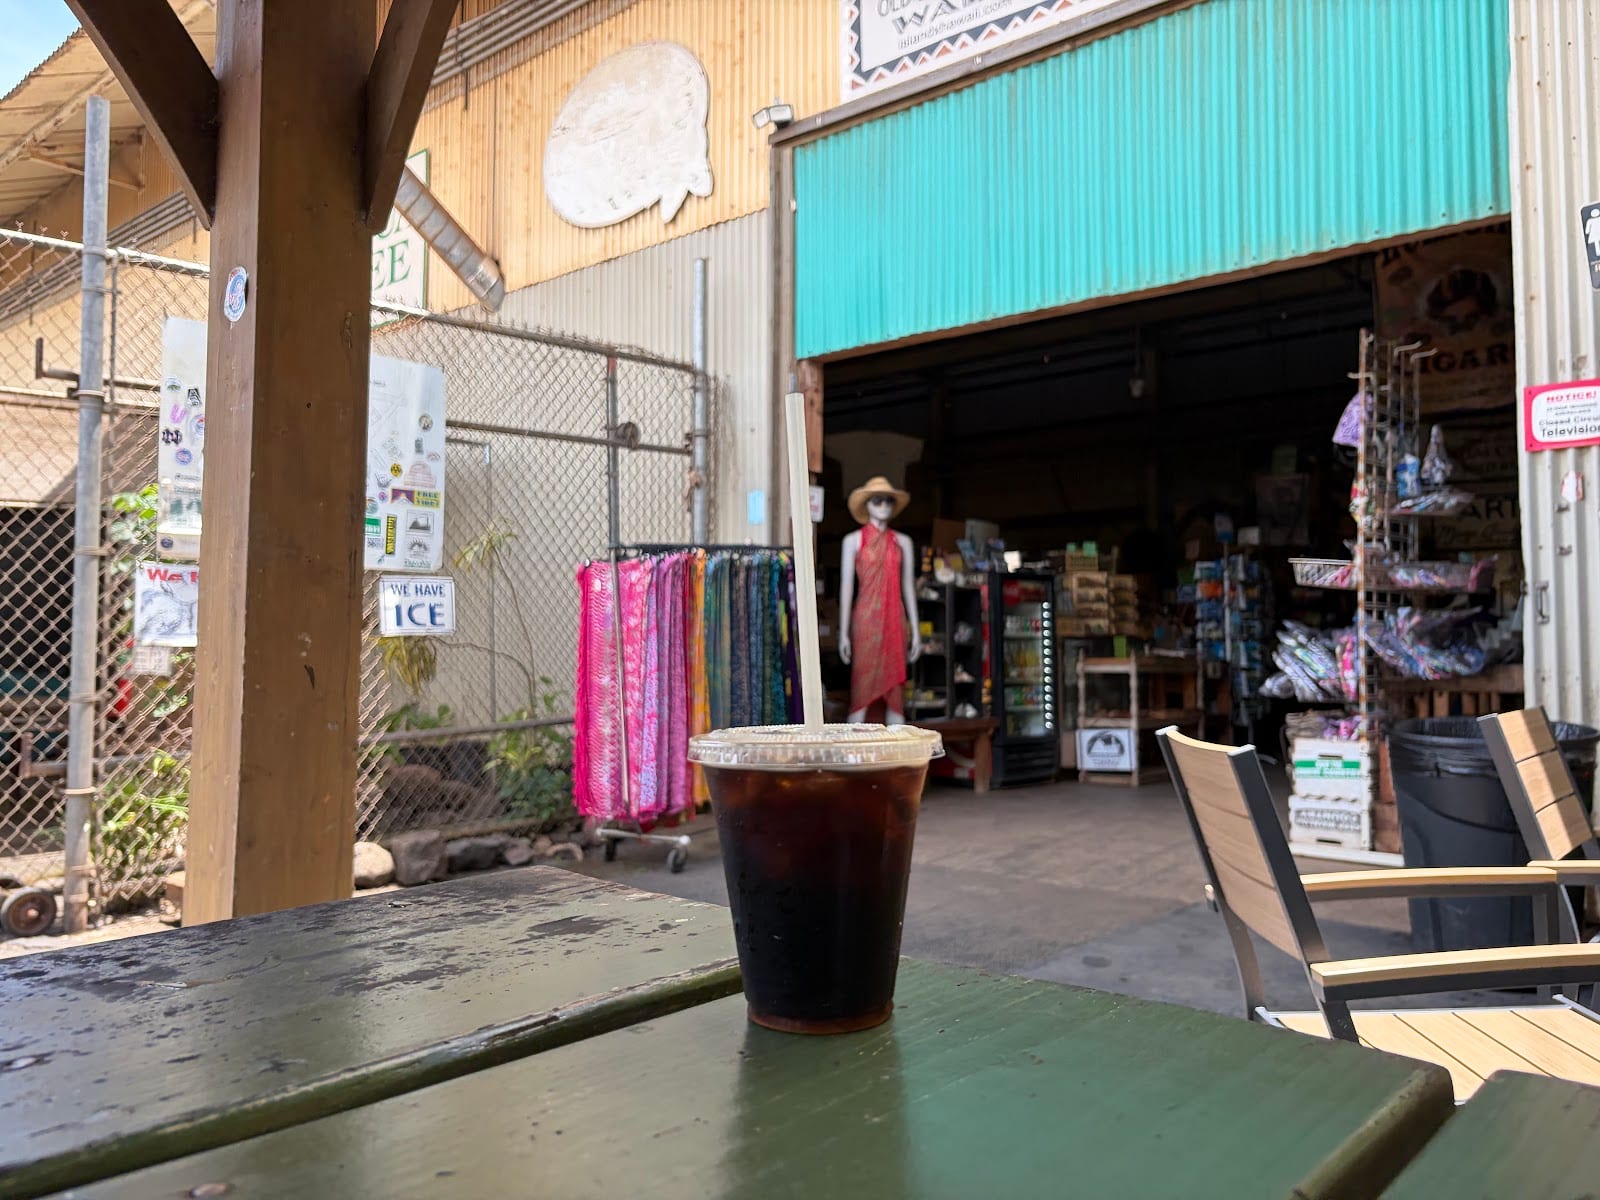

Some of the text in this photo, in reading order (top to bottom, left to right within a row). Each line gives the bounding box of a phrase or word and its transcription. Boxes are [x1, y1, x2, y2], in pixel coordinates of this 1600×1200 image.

[391, 583, 446, 598] WE HAVE
[395, 602, 446, 627] ICE
